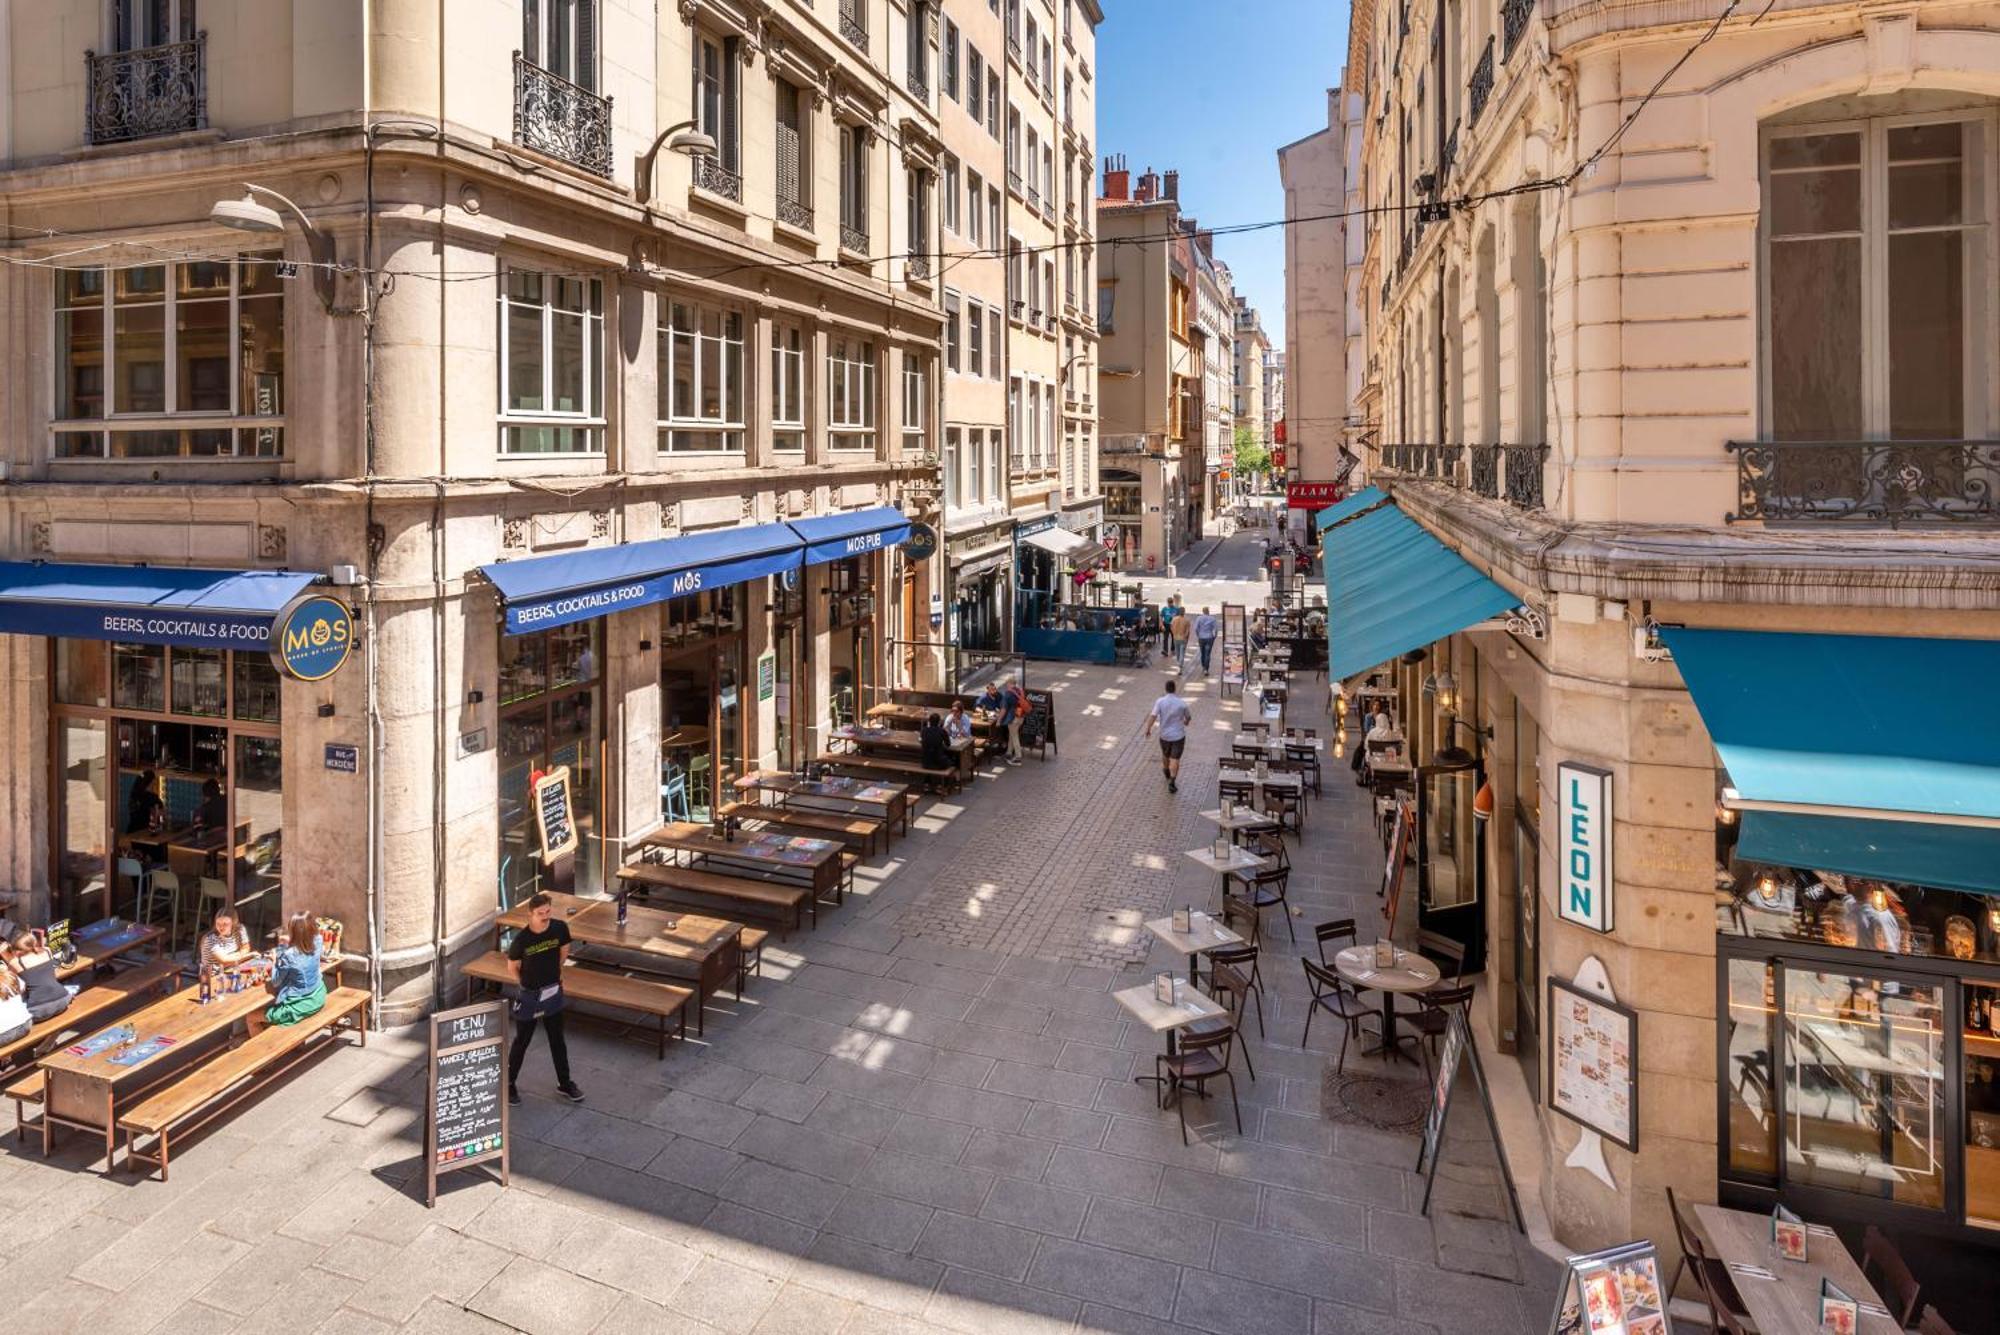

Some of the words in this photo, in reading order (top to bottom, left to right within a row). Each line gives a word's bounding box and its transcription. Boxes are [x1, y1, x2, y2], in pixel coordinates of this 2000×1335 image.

[846, 536, 865, 553] MOS
[866, 533, 881, 548] PUB
[673, 572, 701, 594] MOS
[517, 605, 556, 624] BEERS,
[556, 591, 610, 615] COCKTAILS
[610, 590, 618, 602] &
[618, 585, 645, 601] FOOD
[104, 616, 145, 635] BEERS,
[147, 619, 217, 637] COCKTAILS
[218, 624, 228, 638] &
[229, 625, 270, 640] FOOD
[287, 618, 347, 653] MOS
[453, 1013, 487, 1033] MENU
[470, 1028, 485, 1039] PUB
